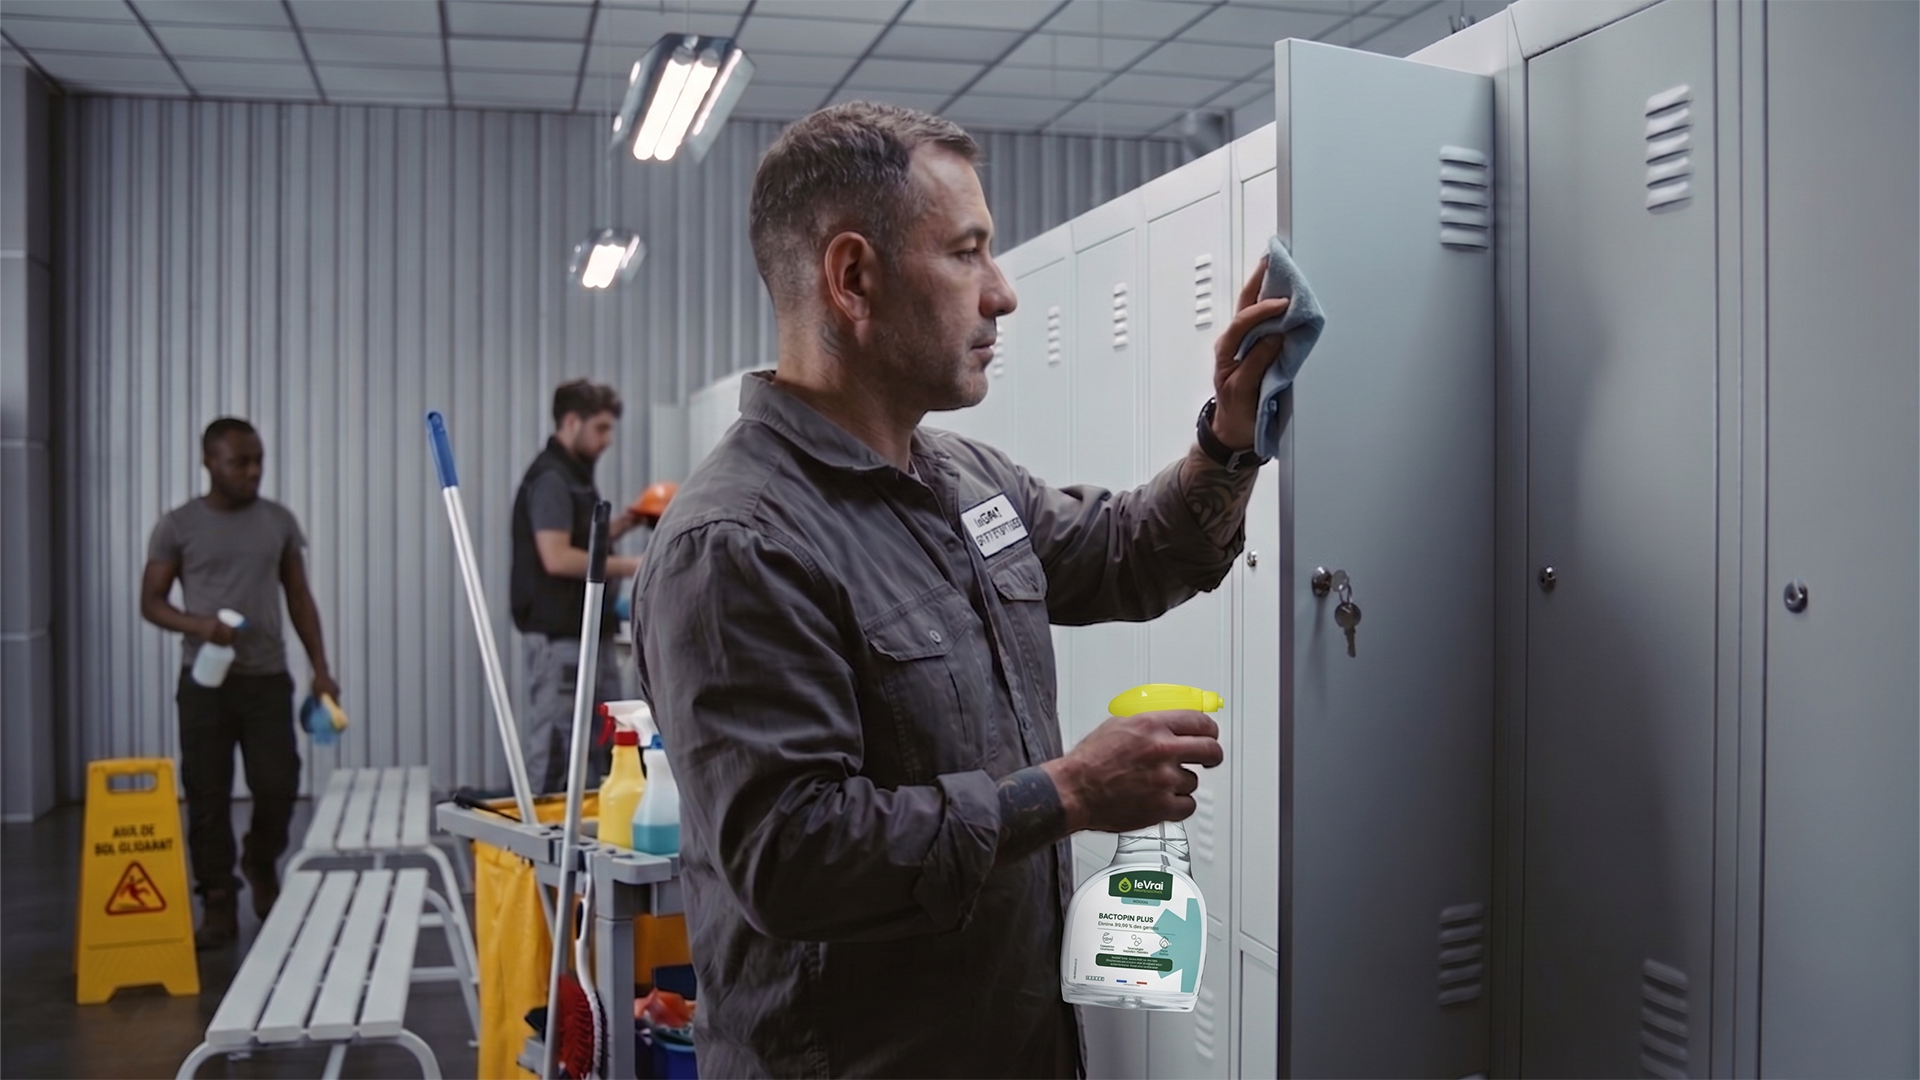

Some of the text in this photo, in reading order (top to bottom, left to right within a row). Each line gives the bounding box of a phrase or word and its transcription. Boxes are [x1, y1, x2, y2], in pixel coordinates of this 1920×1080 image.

[1134, 879, 1164, 891] leVrai
[1098, 912, 1154, 923] BACTOPIN PLUS
